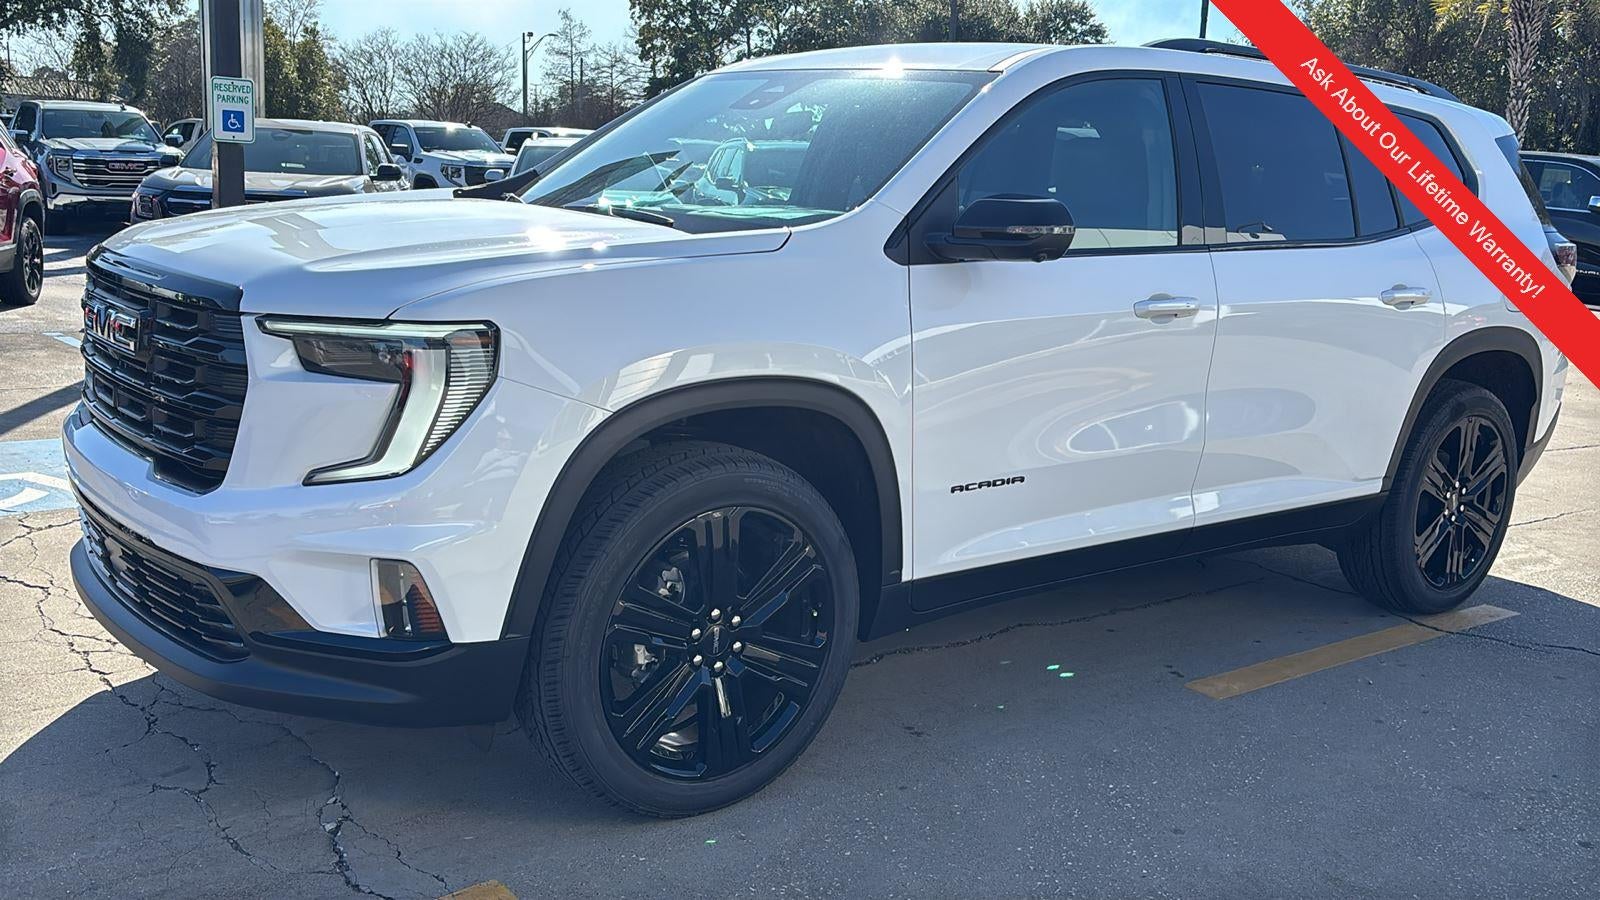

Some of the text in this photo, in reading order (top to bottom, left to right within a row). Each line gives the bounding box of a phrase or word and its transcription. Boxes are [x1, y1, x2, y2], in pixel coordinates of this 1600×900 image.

[213, 83, 252, 94] RESERVED
[216, 94, 250, 105] PARKING
[108, 162, 145, 170] GMC
[950, 476, 1026, 494] ACADIA
